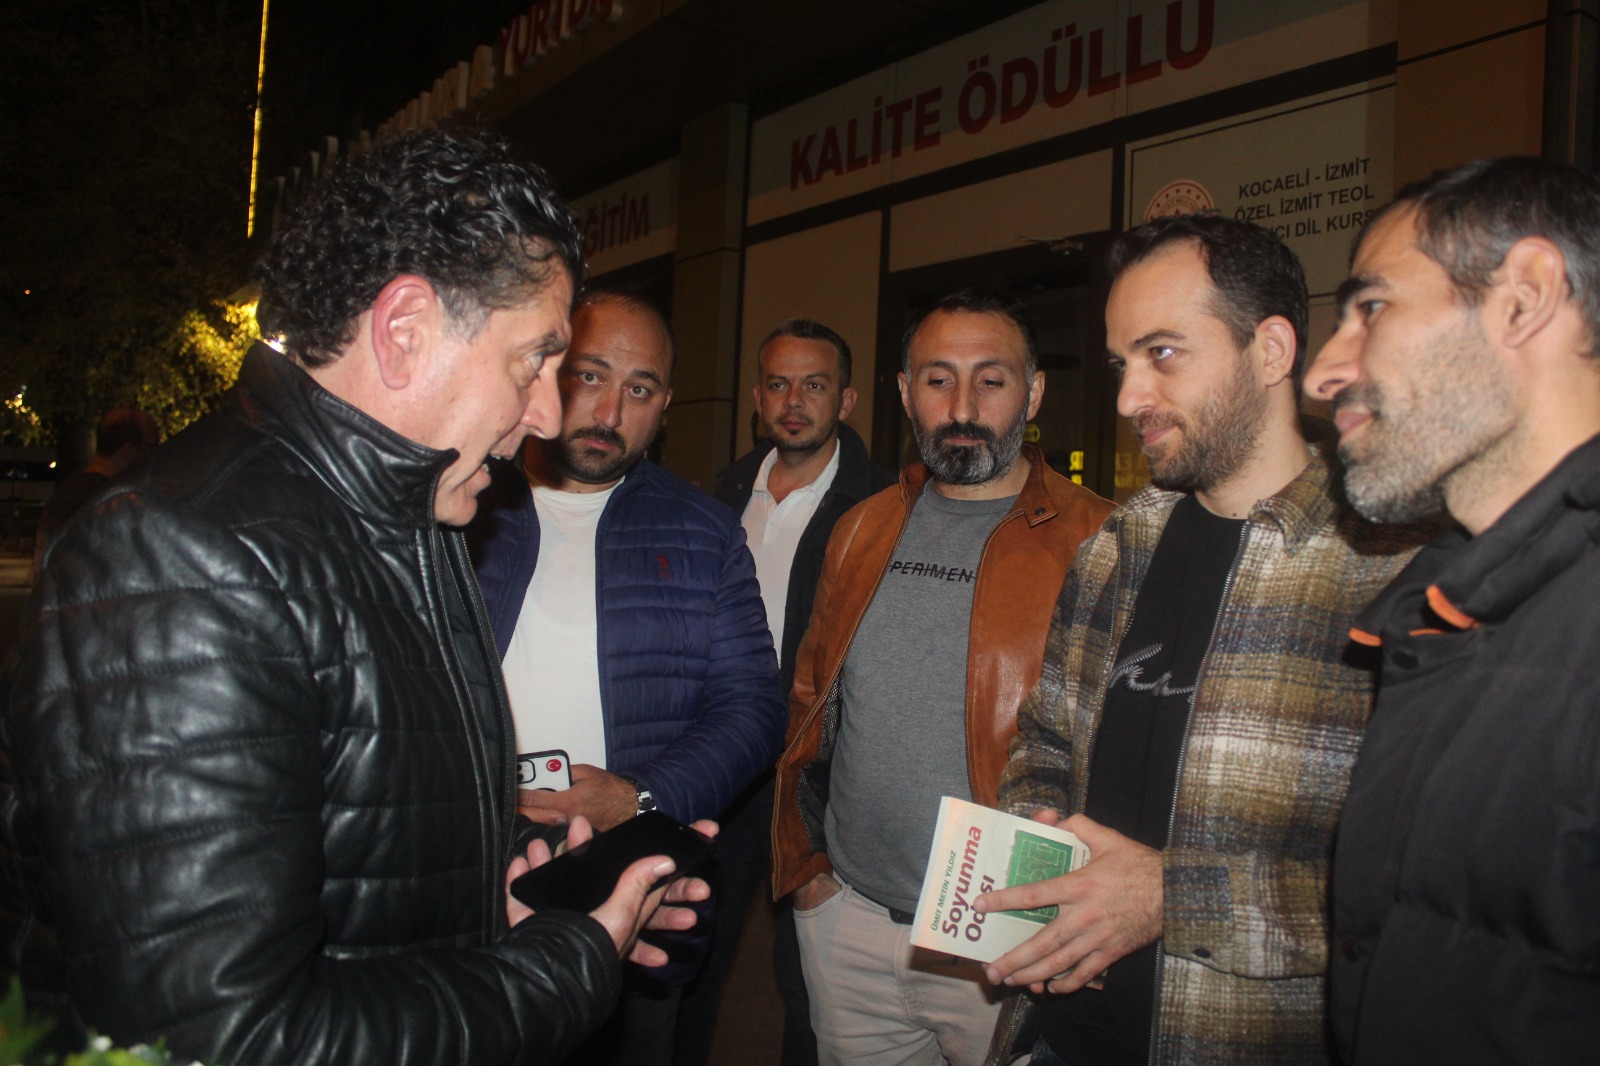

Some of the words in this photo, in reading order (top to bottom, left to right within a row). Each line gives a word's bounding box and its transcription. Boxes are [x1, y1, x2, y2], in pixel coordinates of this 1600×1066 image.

[789, 87, 942, 190] KALİTE
[1234, 202, 1275, 224] ÖZEL
[1280, 192, 1323, 215] İZMİT
[1328, 184, 1374, 206] TEOL
[1239, 168, 1310, 199] KOCAELİ
[1325, 157, 1371, 182] İZMİT
[1295, 217, 1321, 237] DİL
[938, 880, 949, 908] METİN
[945, 850, 957, 878] YILDIZ
[942, 826, 982, 938] Soyunma
[965, 875, 995, 942] Odsı
